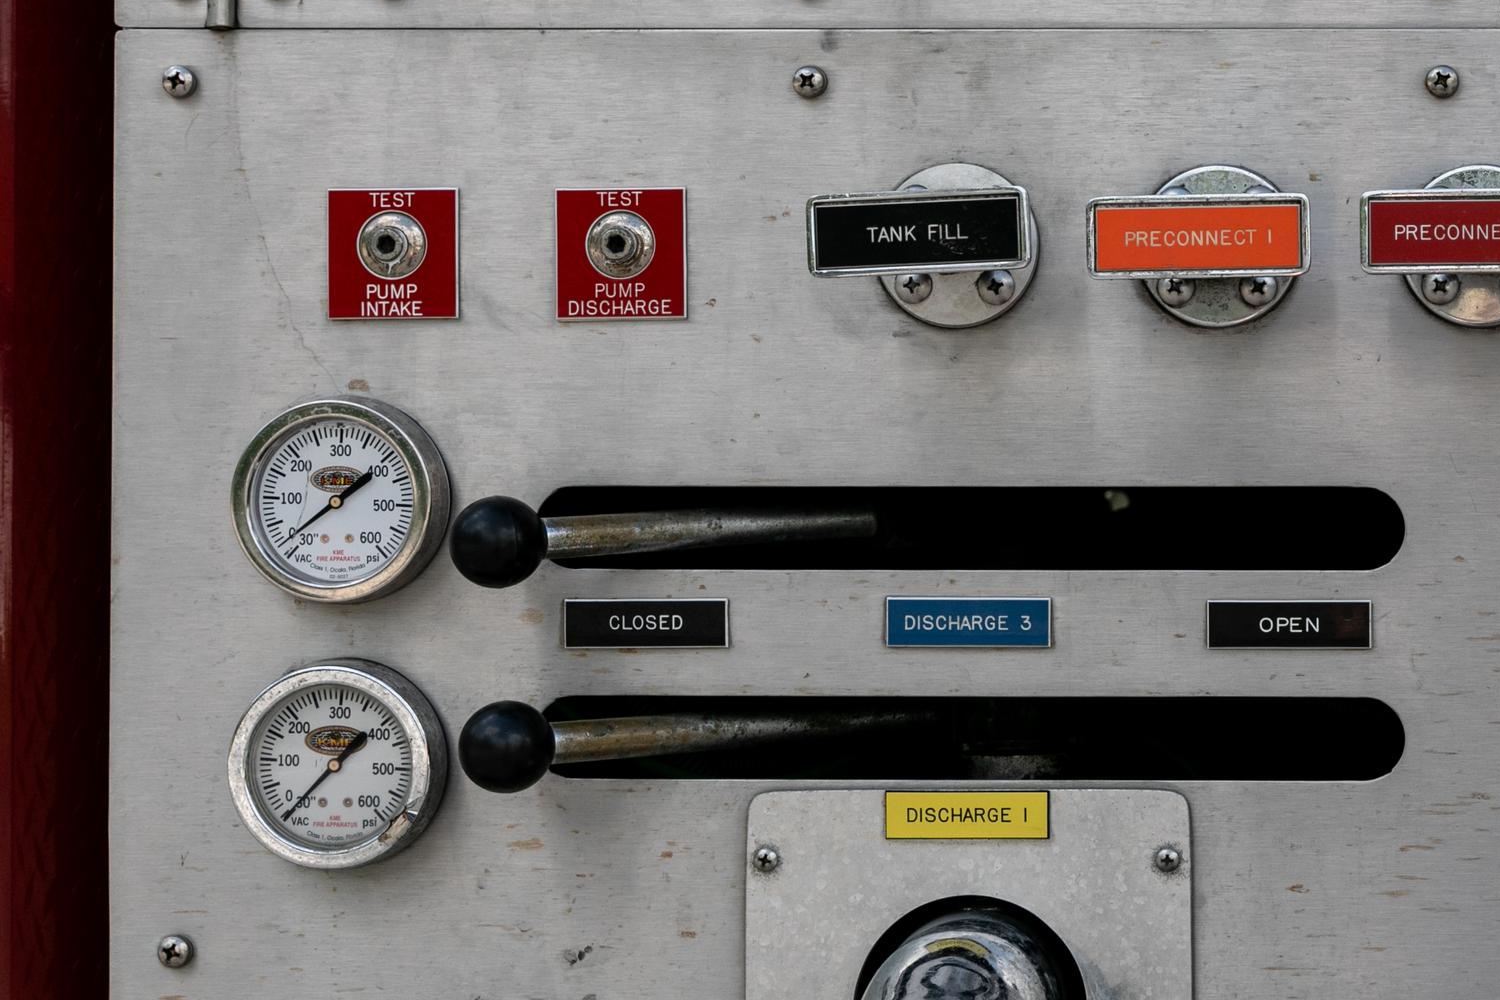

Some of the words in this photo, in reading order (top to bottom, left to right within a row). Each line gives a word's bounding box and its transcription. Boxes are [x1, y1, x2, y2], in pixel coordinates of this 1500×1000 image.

[369, 192, 415, 208] TEST
[596, 191, 642, 206] TEST
[866, 224, 917, 244] TANK
[928, 223, 968, 240] FILL
[1124, 229, 1260, 247] PRECONNECT
[366, 284, 418, 299] PUMP
[595, 283, 646, 298] PUMP
[361, 301, 423, 317] INTAKE
[568, 300, 673, 315] DISCHARGE
[329, 444, 352, 457] 300
[373, 500, 395, 512] 500
[294, 553, 312, 563] VAC
[609, 613, 684, 632] CLOSED
[903, 614, 1009, 632] DISCHARGE
[1020, 614, 1032, 632] 3
[1259, 616, 1320, 634] OPEN
[329, 706, 351, 719] 300
[278, 754, 299, 767] 100
[372, 763, 394, 775] 500
[906, 807, 1011, 825] DISCHARGE
